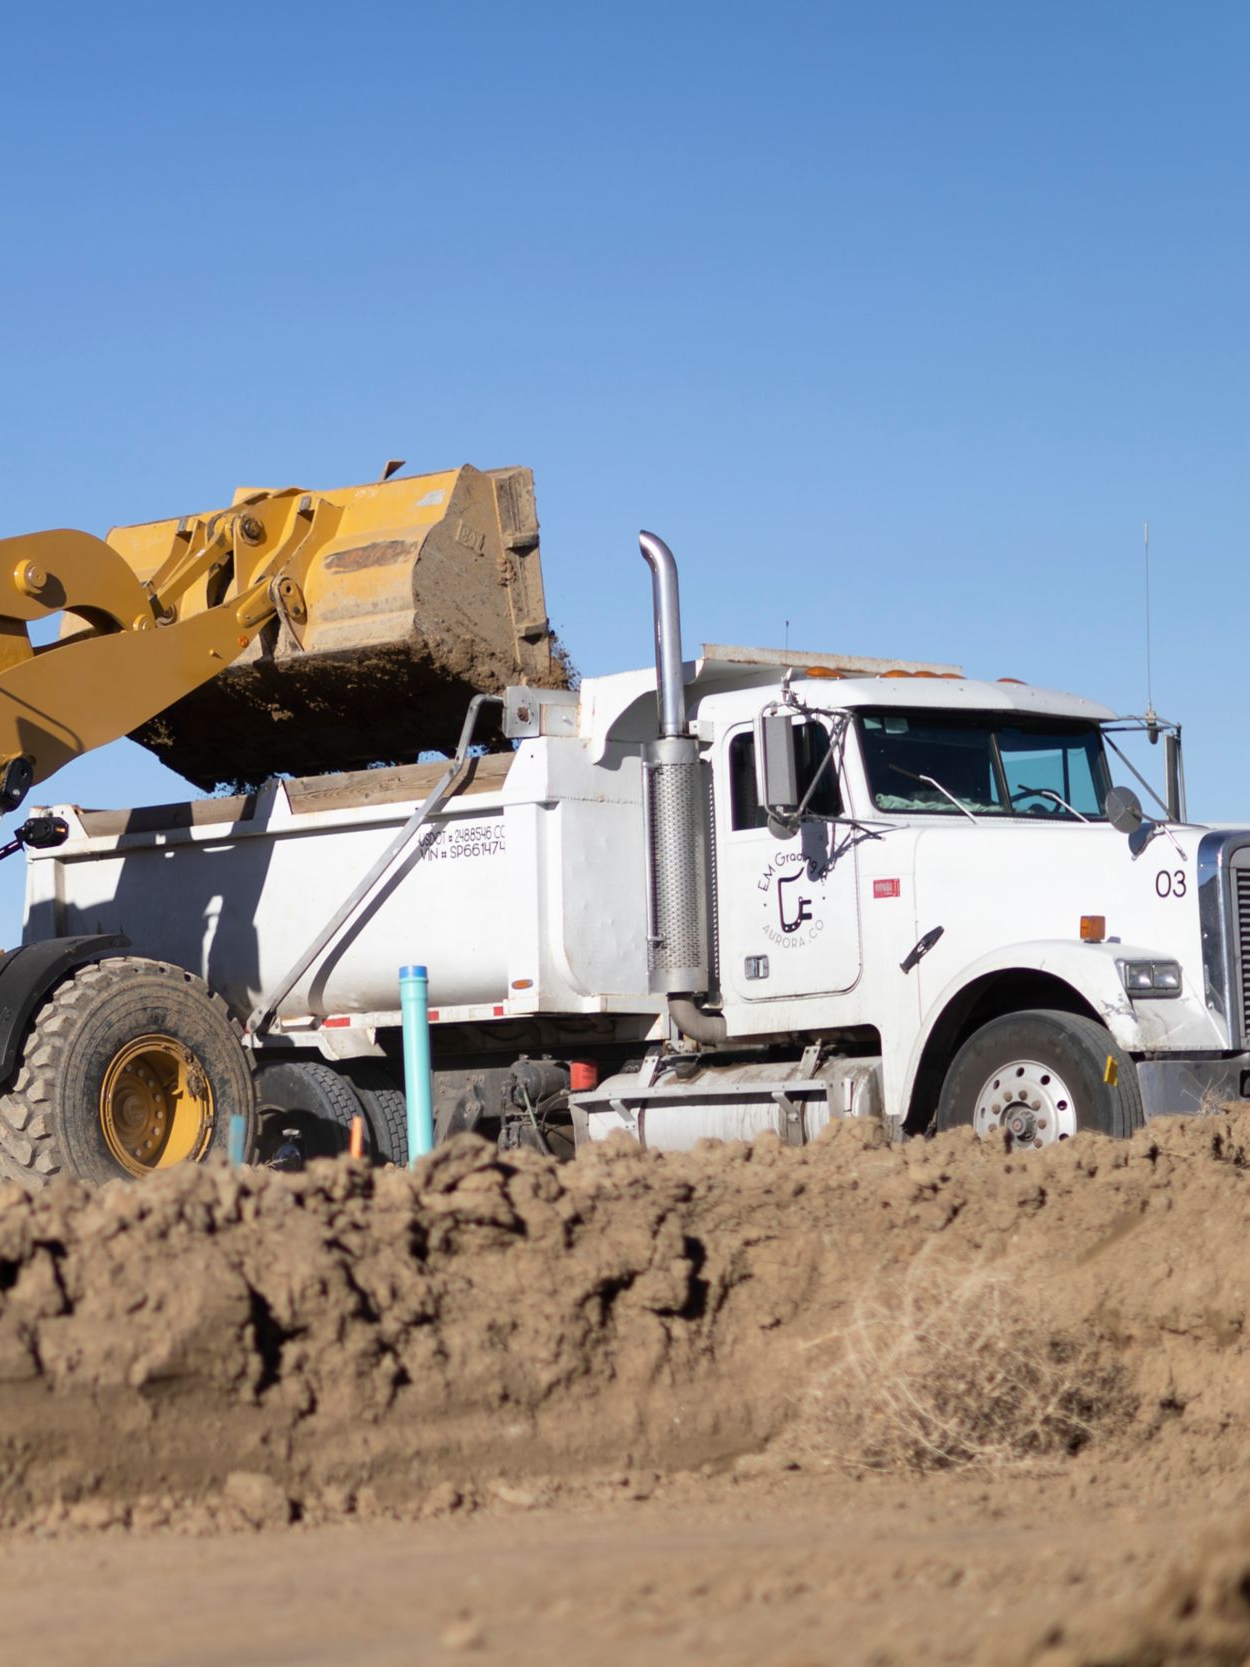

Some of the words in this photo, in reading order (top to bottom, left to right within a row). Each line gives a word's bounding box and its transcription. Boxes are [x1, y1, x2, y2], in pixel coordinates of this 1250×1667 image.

[419, 847, 439, 861] VIN
[757, 864, 776, 892] EM
[1155, 869, 1187, 898] 03
